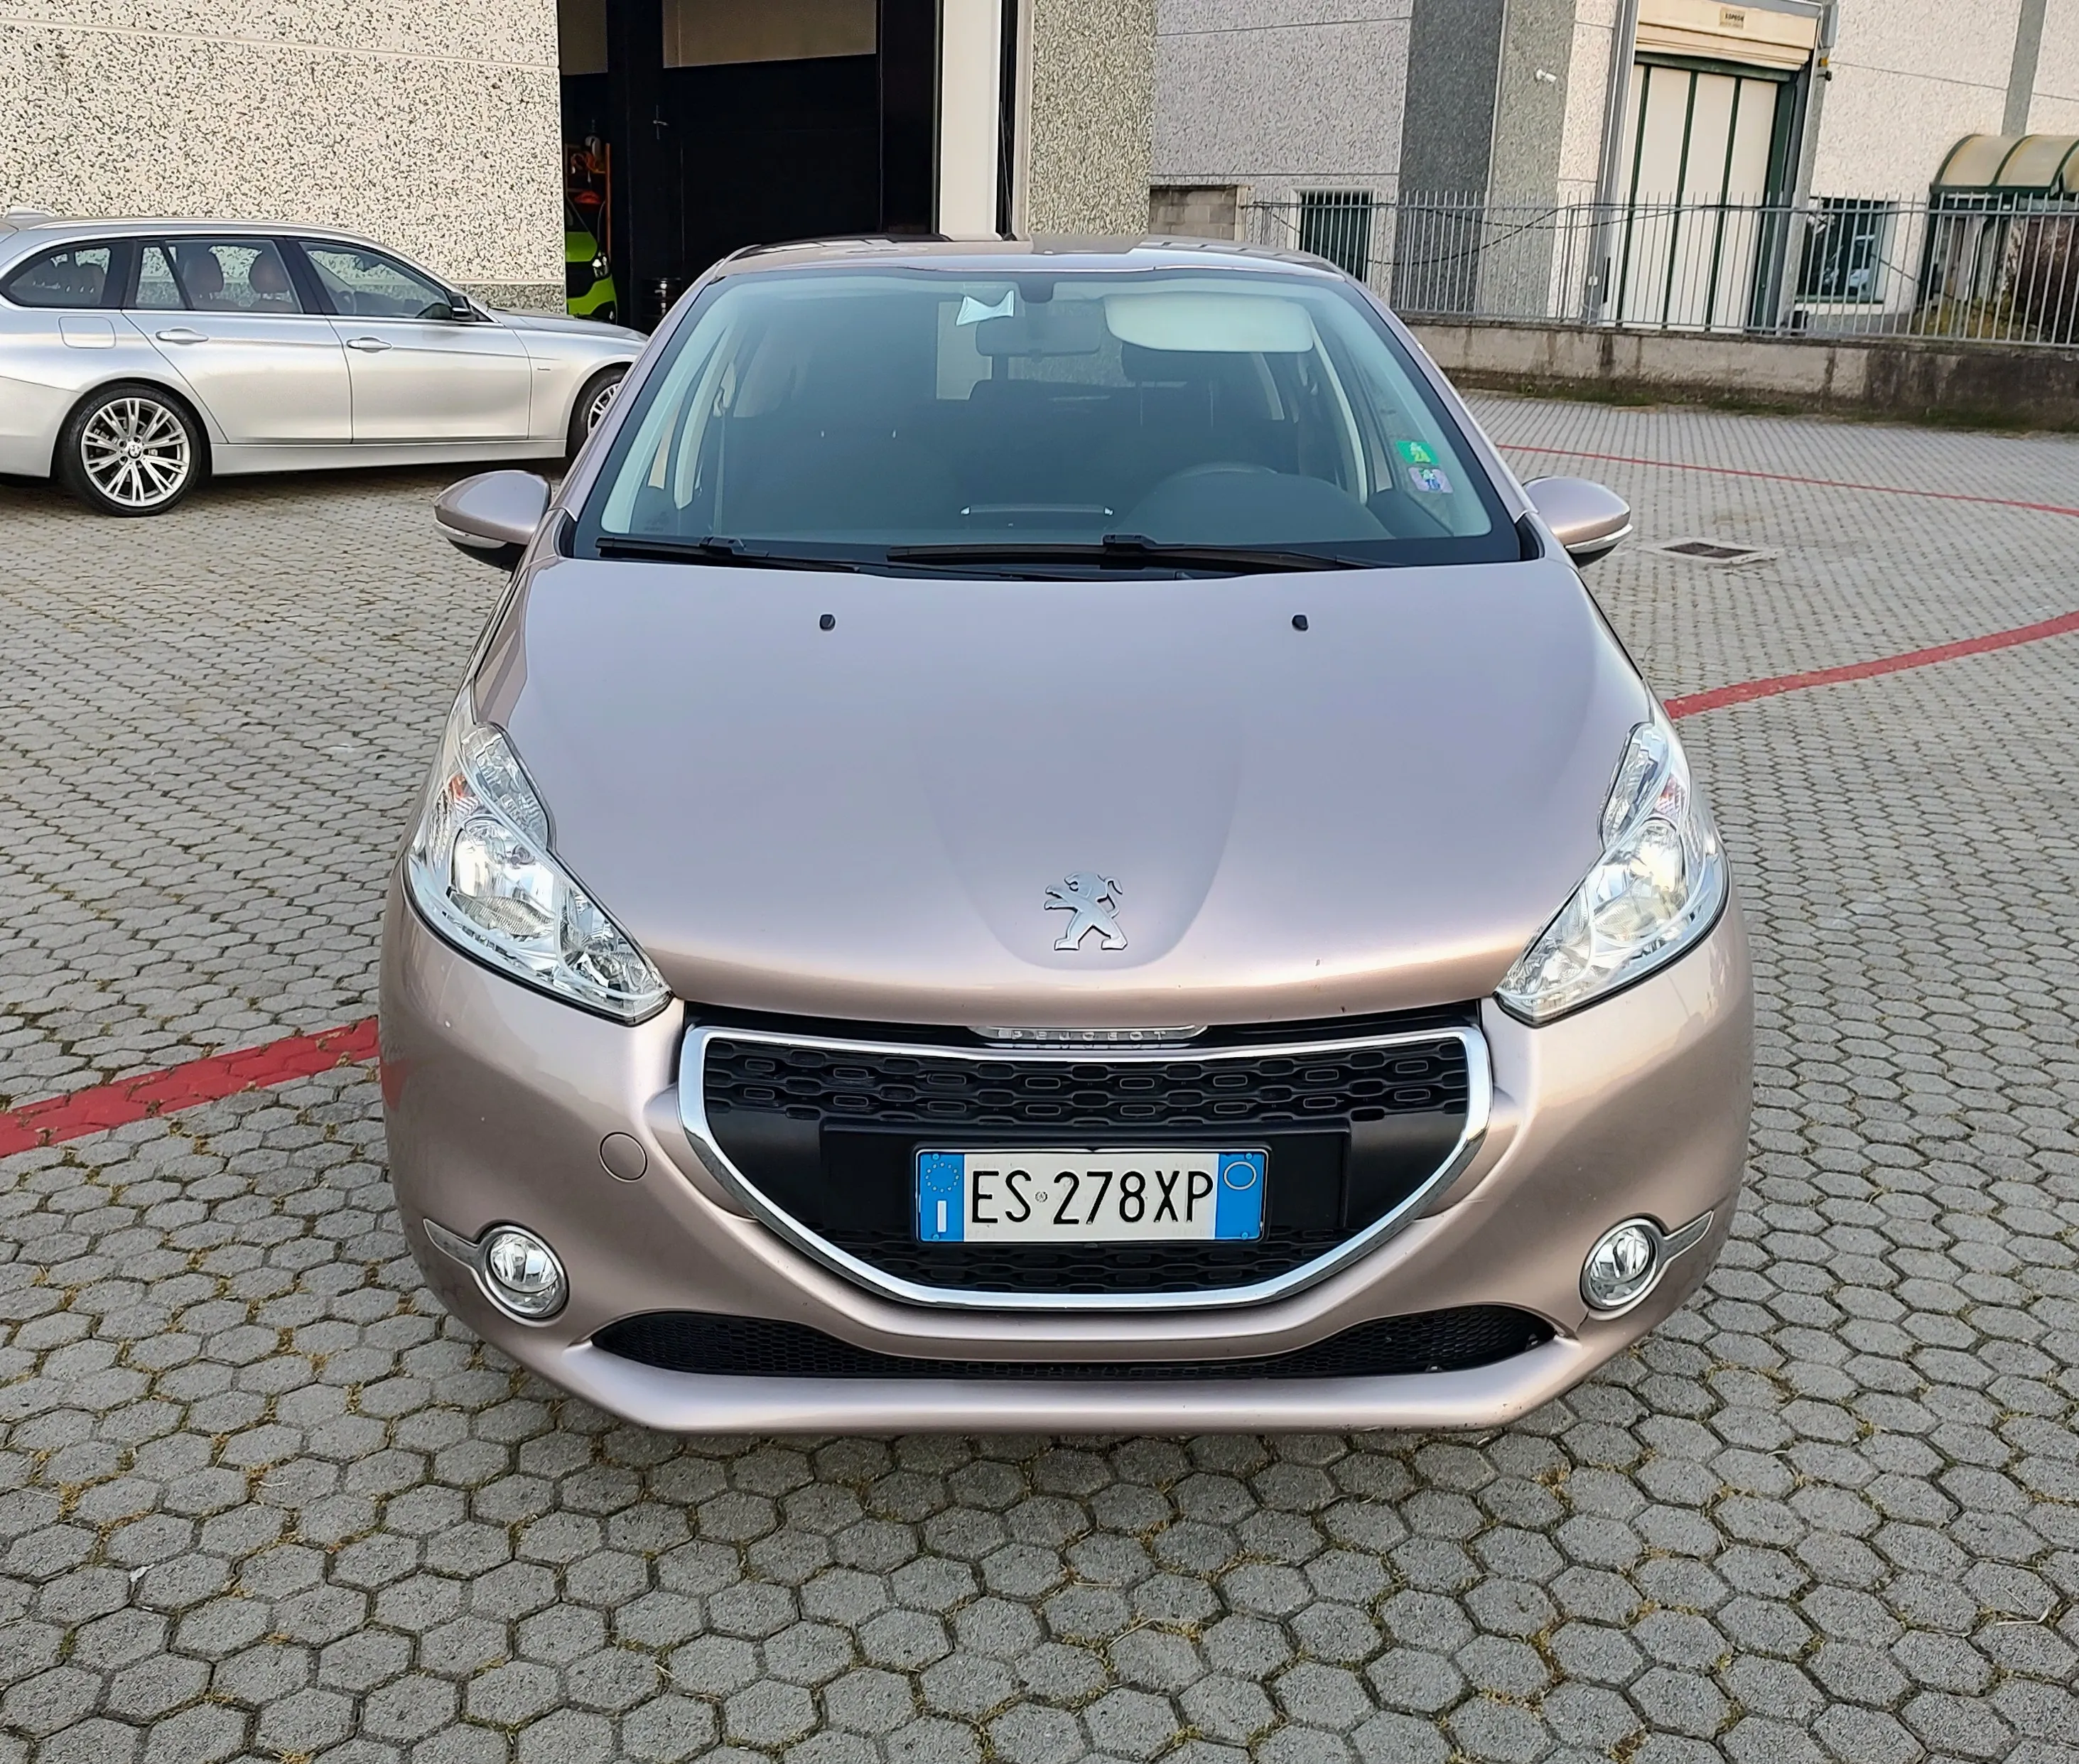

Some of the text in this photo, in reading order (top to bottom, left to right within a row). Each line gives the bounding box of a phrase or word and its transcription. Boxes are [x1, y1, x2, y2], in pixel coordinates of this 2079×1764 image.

[1012, 1030, 1166, 1041] PEUGEOT
[971, 1169, 1214, 1225] ES 278XP
